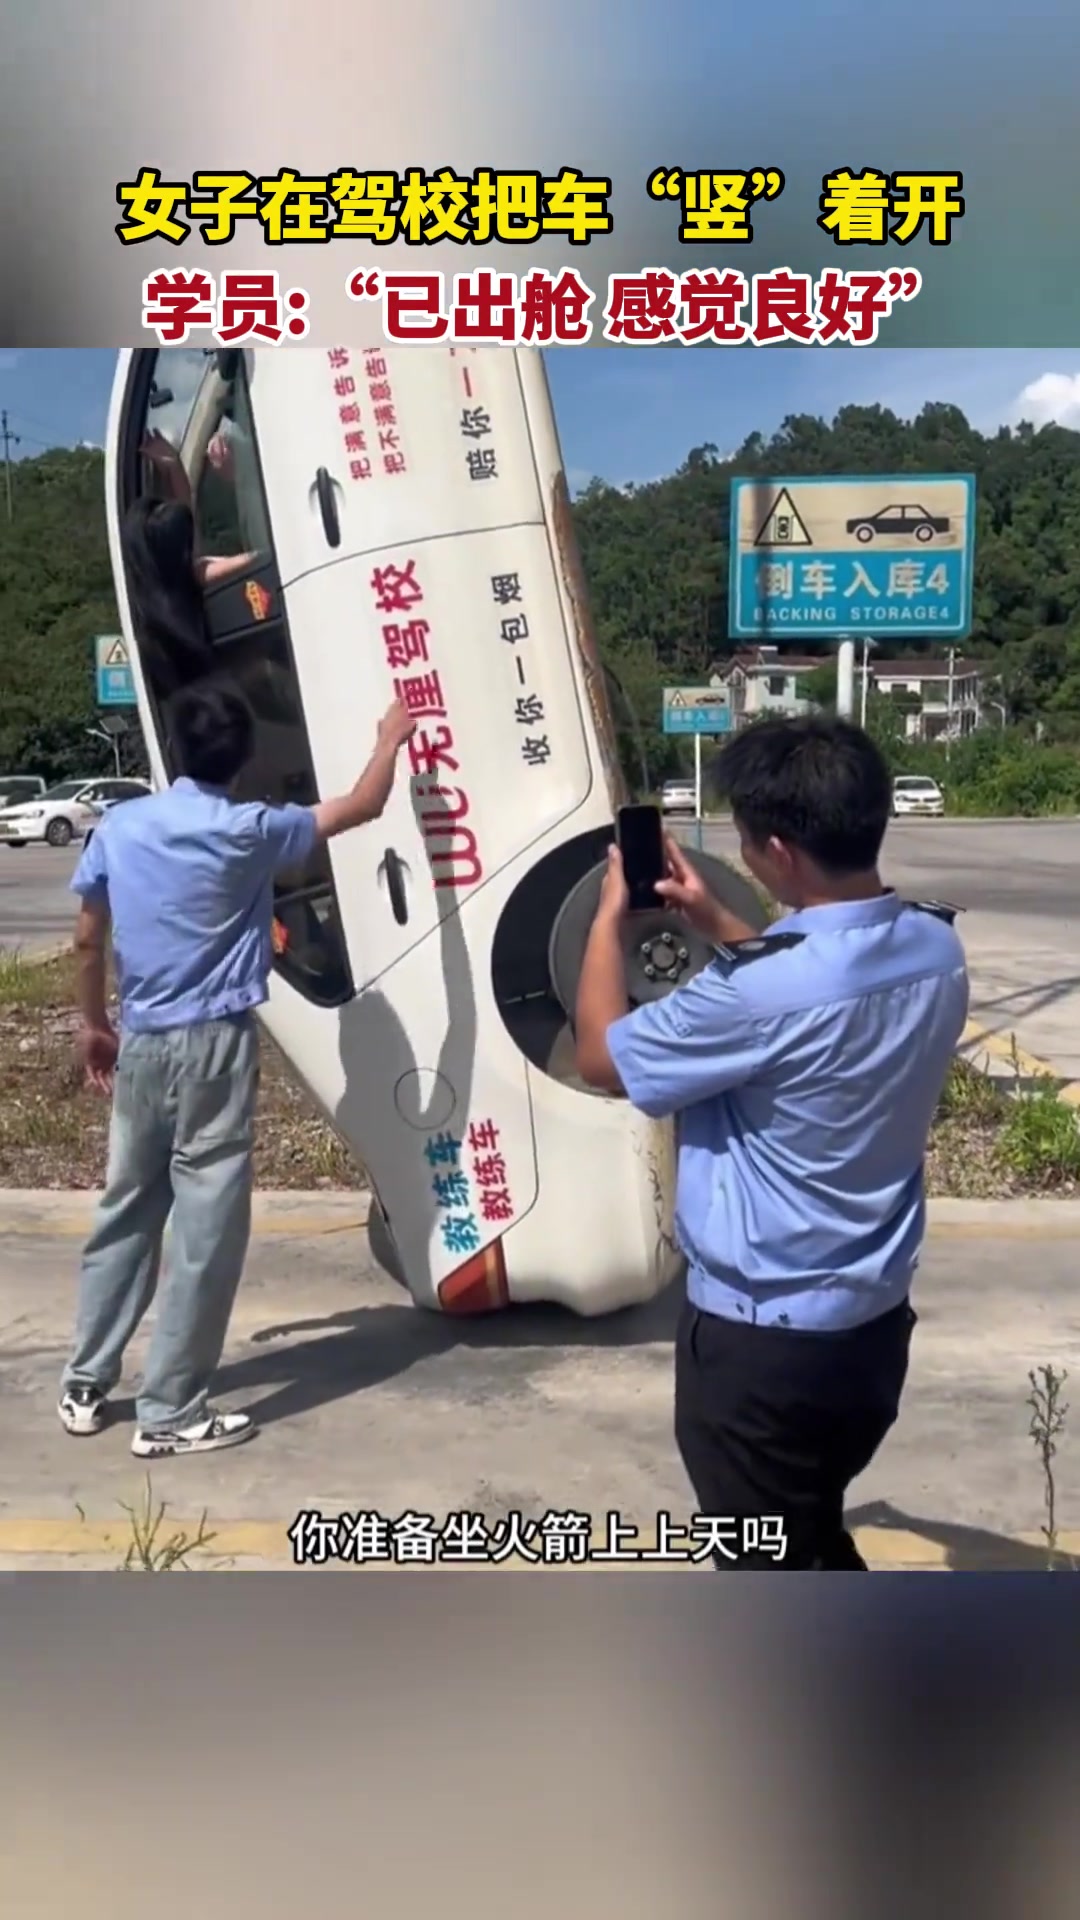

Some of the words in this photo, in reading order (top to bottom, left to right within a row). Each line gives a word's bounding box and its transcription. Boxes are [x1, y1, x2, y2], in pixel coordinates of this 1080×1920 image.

[450, 348, 498, 481] 赔你一
[490, 572, 551, 766] 收你一包烟
[850, 606, 950, 621] STORAGE4
[424, 1130, 480, 1253] 教练车
[468, 1117, 514, 1221] 教练车
